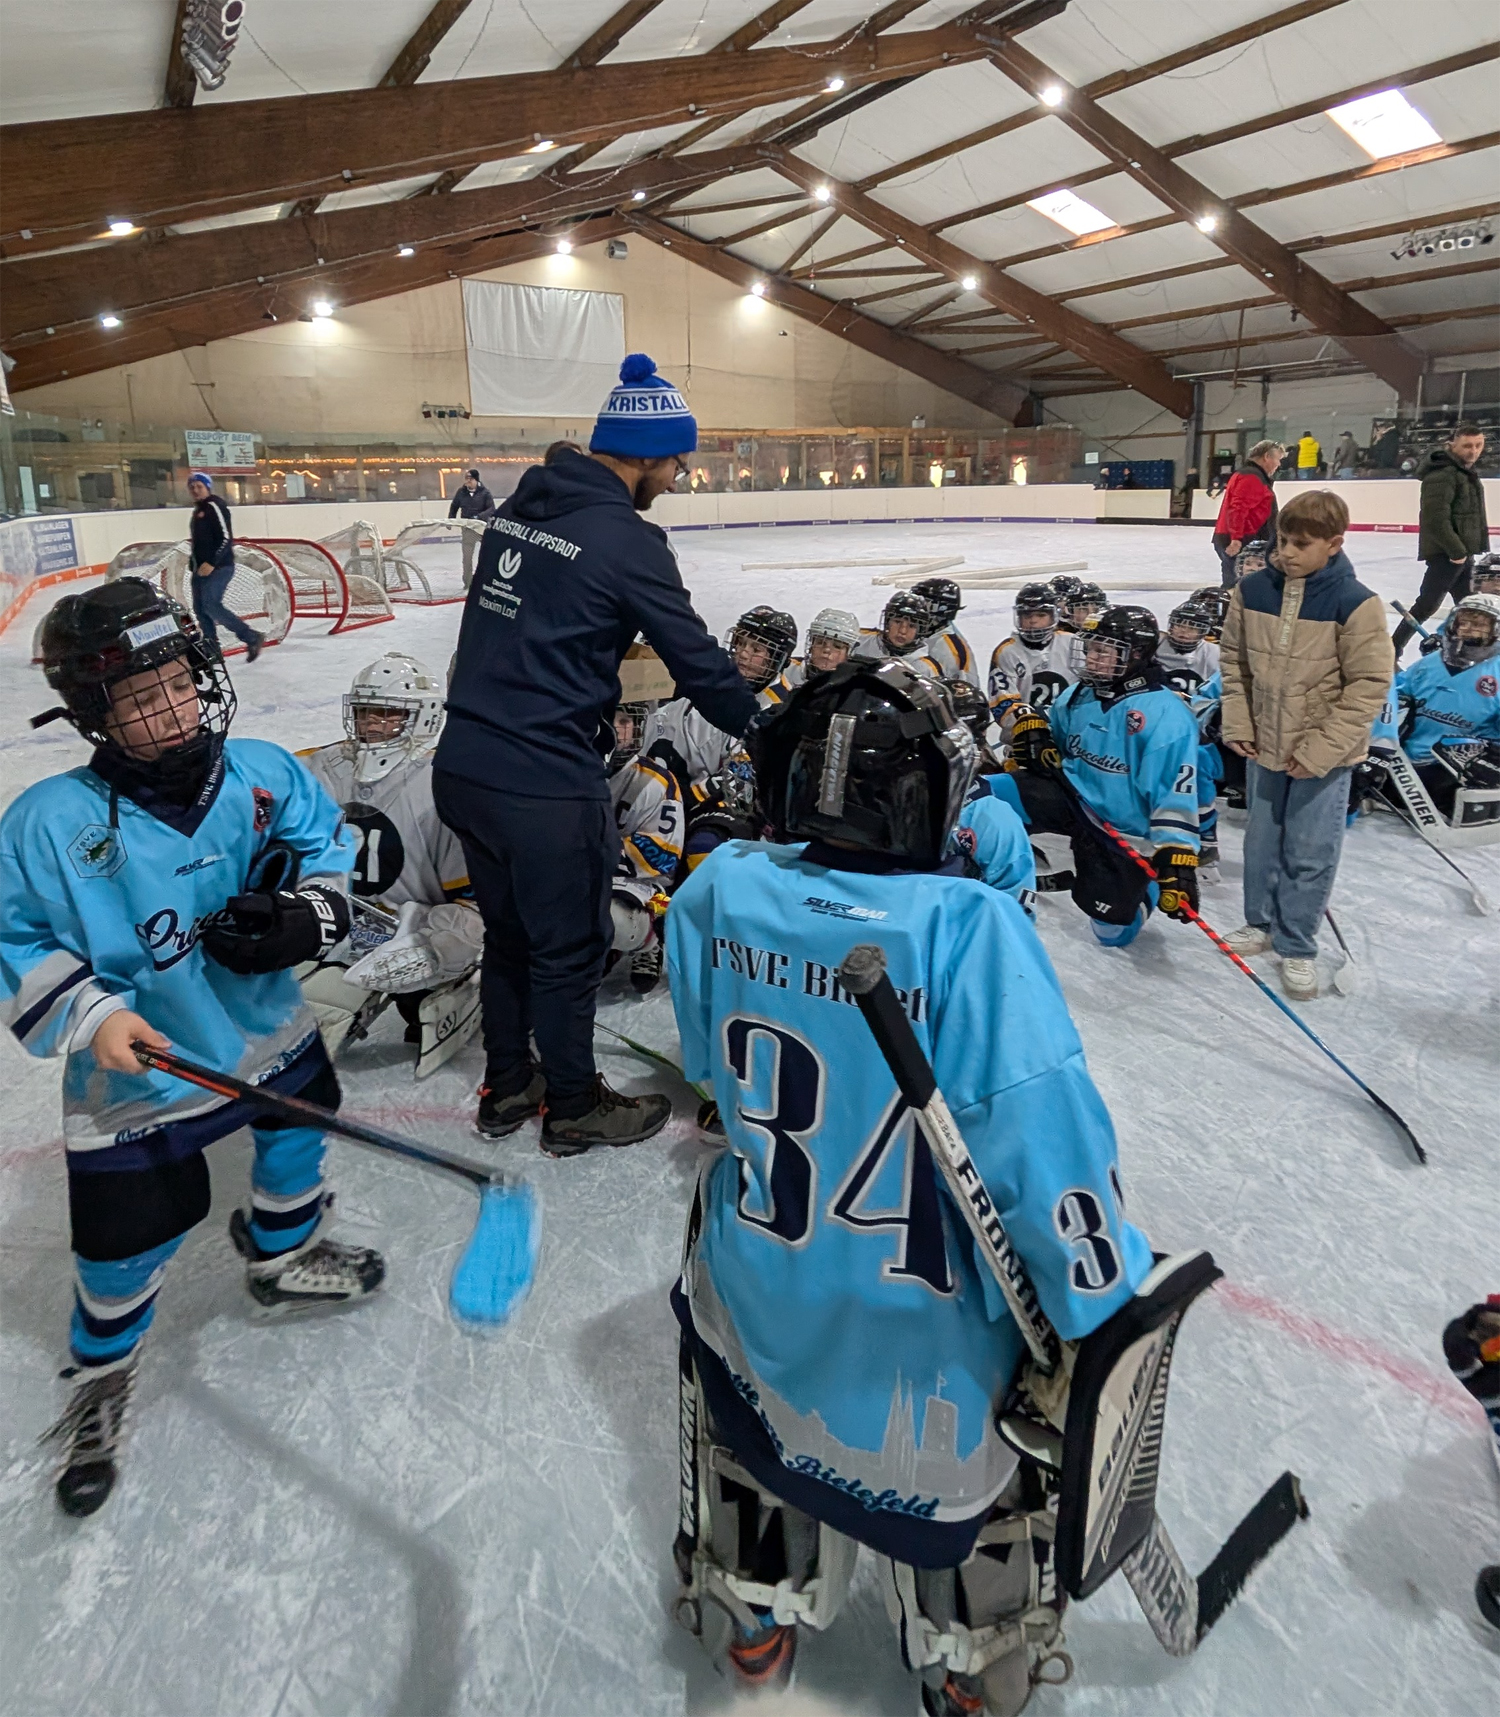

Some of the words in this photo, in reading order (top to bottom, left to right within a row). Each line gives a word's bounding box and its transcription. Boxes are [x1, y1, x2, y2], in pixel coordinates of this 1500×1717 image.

[607, 394, 687, 412] KRISTALL
[187, 431, 229, 441] EISSPORT
[232, 433, 252, 442] BEIM
[492, 517, 531, 541] KRISTALL
[529, 529, 582, 560] LIPPSTADT
[1067, 734, 1131, 773] Crocodiles
[1173, 764, 1197, 794] 2
[1390, 756, 1438, 827] FRONTIER
[658, 805, 677, 834] 5
[711, 936, 791, 989] TSVE
[722, 1015, 955, 1296] 34
[956, 1157, 1063, 1367] FRONTIER
[786, 1455, 941, 1520] Bielefeld
